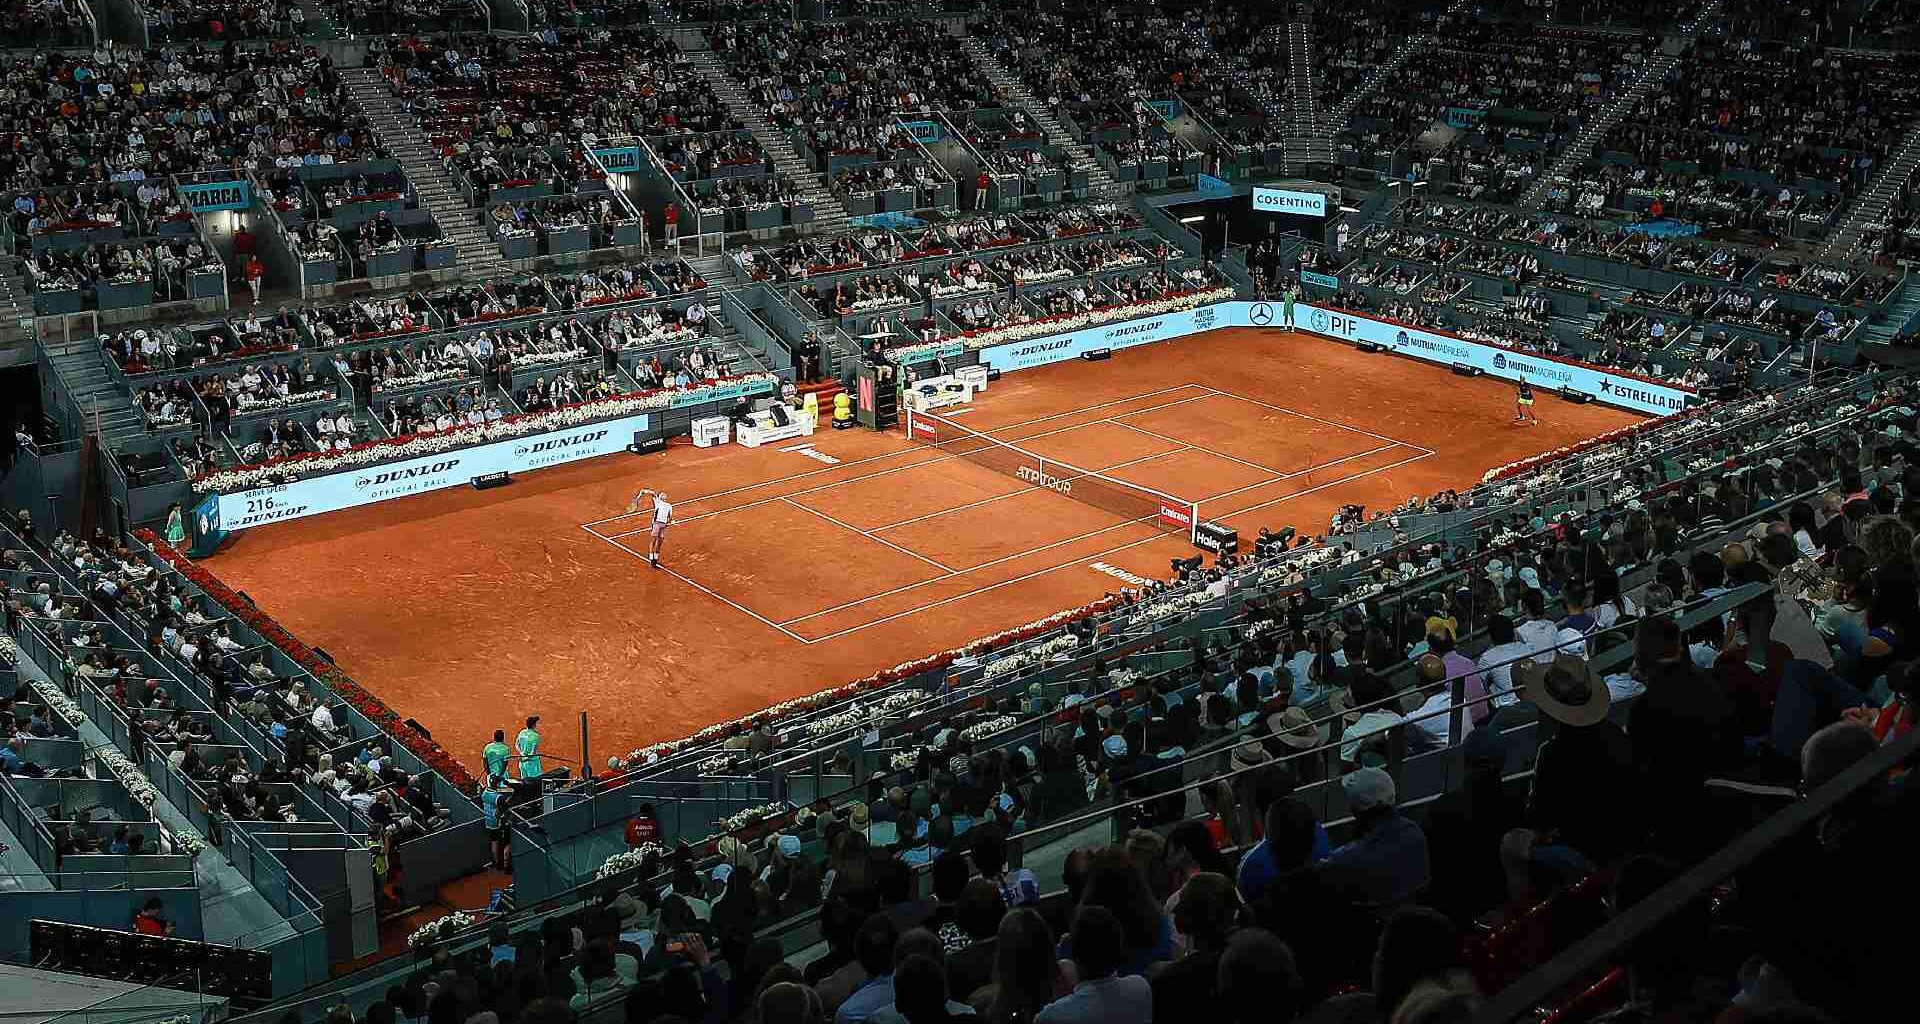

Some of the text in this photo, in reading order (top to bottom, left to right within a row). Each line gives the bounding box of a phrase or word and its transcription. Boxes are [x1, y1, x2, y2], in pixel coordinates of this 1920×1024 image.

[1256, 194, 1321, 209] COSENTINO
[1114, 321, 1163, 337] DUNLOP
[1331, 315, 1357, 336] PIF
[1020, 338, 1073, 356] DUNLOP
[859, 375, 872, 412] N
[1614, 385, 1666, 408] ESTRELLA
[530, 430, 609, 453] DUNLOP
[528, 446, 597, 466] OFFICIAL BALL
[374, 459, 460, 485] DUNLOP
[1016, 466, 1072, 495] ATP TOUR
[244, 489, 266, 498] SERVE
[371, 477, 447, 498] OFFICIAL BALL
[241, 505, 308, 525] DUNLOP
[247, 497, 274, 513] 216
[1161, 505, 1190, 524] Emirates
[1196, 532, 1221, 550] Haier
[1088, 561, 1145, 585] MADRID
